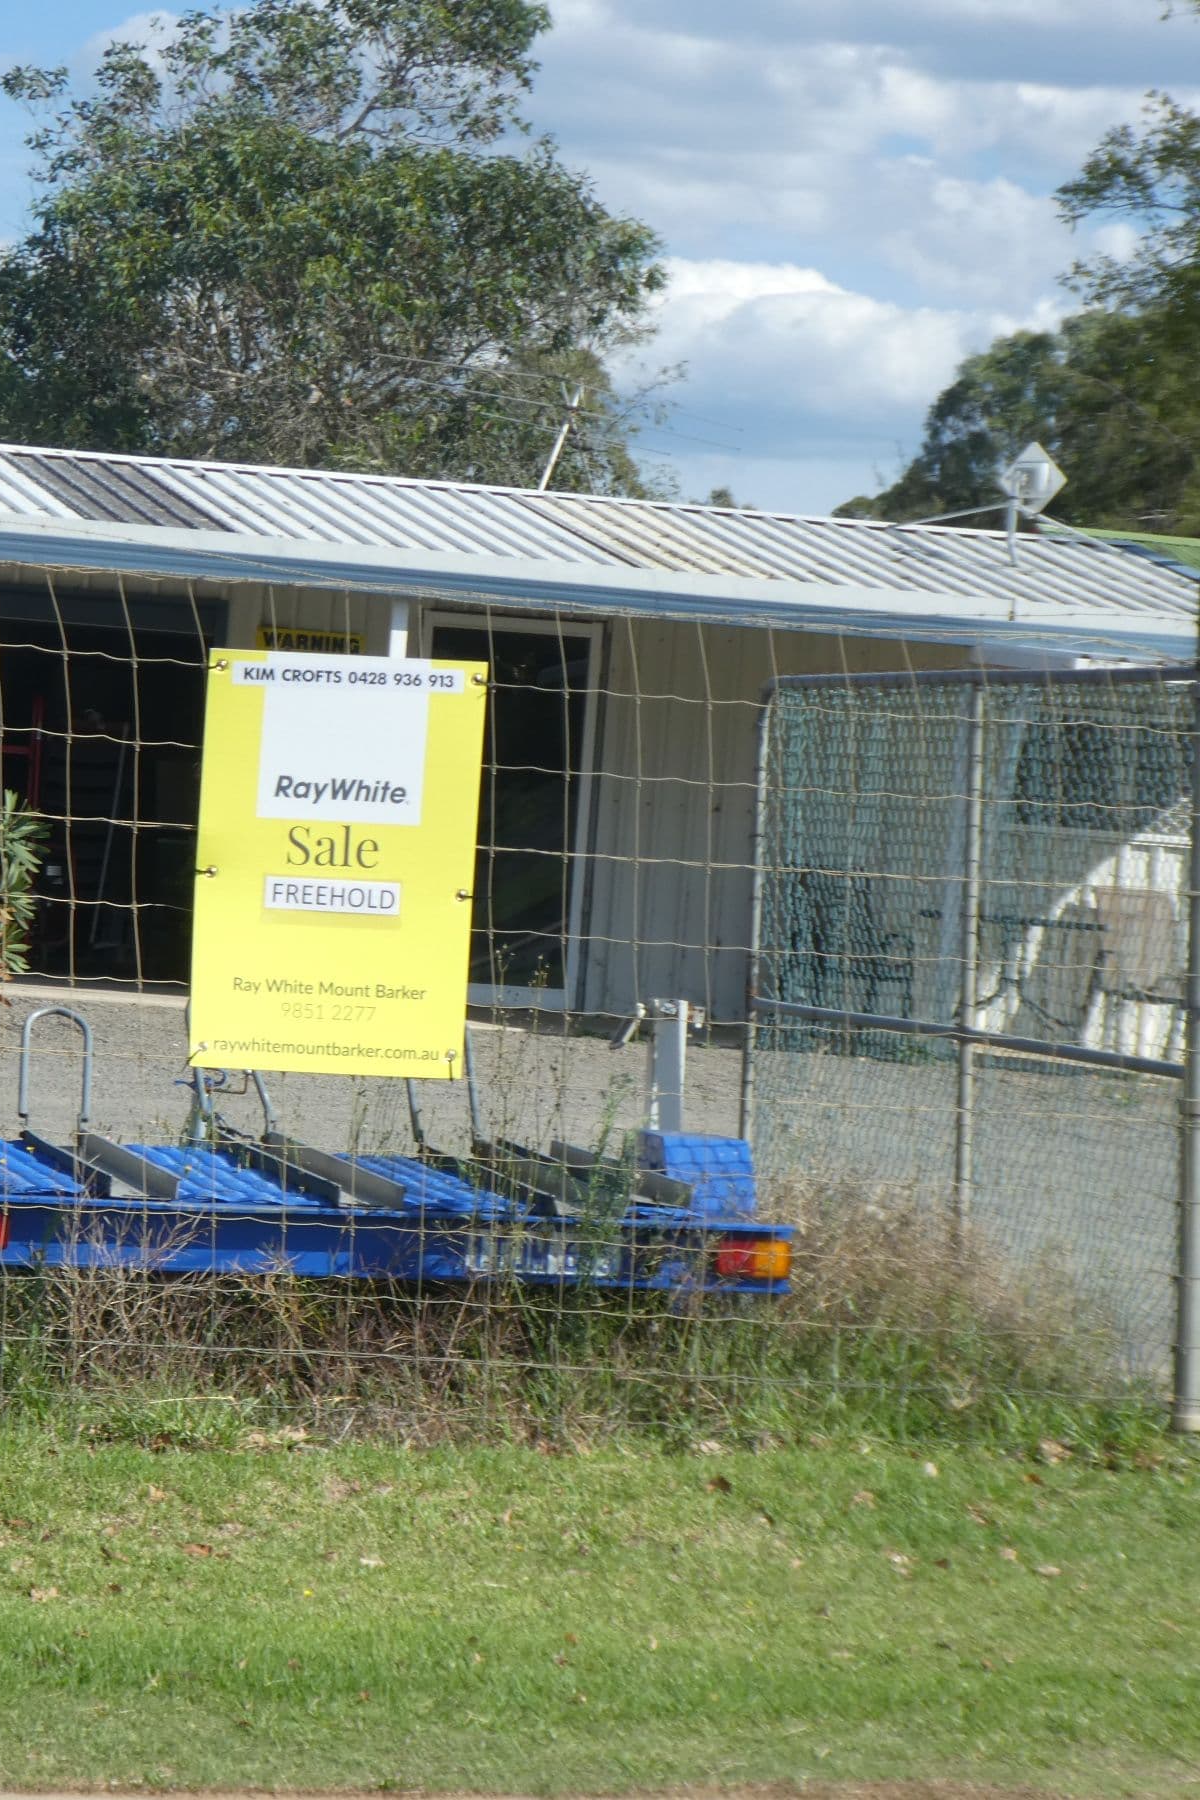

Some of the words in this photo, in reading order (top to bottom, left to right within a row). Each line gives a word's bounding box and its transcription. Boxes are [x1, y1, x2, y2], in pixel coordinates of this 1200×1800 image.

[243, 667, 275, 681] KIM
[282, 669, 342, 684] CROFTS
[348, 671, 387, 686] 0428
[394, 673, 422, 687] 936
[429, 674, 454, 688] 913
[274, 775, 407, 804] RayWhite
[287, 825, 379, 868] Sale
[272, 883, 395, 910] FREEHOLD
[233, 977, 261, 993] Ray
[267, 979, 313, 995] White
[319, 982, 371, 998] Mount
[375, 985, 426, 1000] Barker
[281, 1002, 329, 1020] 9851
[332, 1005, 376, 1022] 2277
[213, 1037, 440, 1061] raywhitemountbarker.com.au
